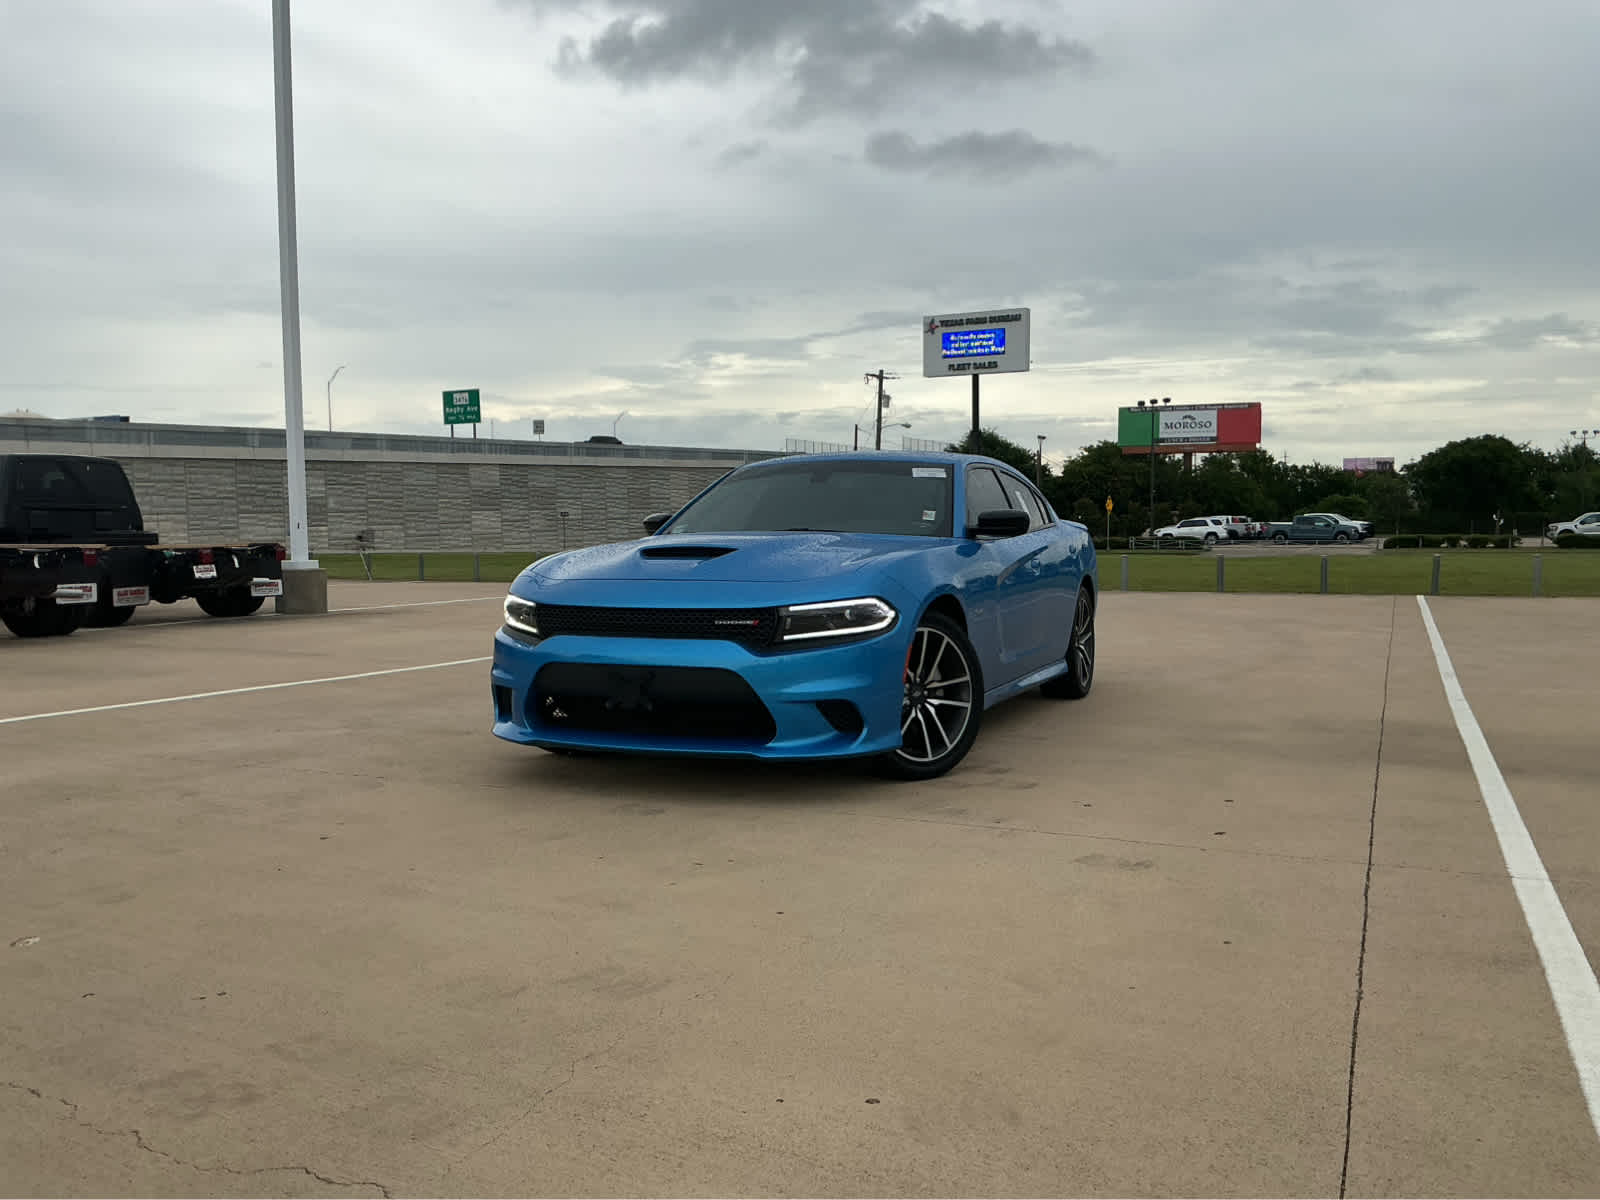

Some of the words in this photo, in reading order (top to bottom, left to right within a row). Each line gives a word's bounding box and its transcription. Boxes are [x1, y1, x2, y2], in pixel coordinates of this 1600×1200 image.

[948, 363, 971, 371] FLEET
[973, 361, 998, 370] SALES
[1164, 420, 1212, 430] MOROSO
